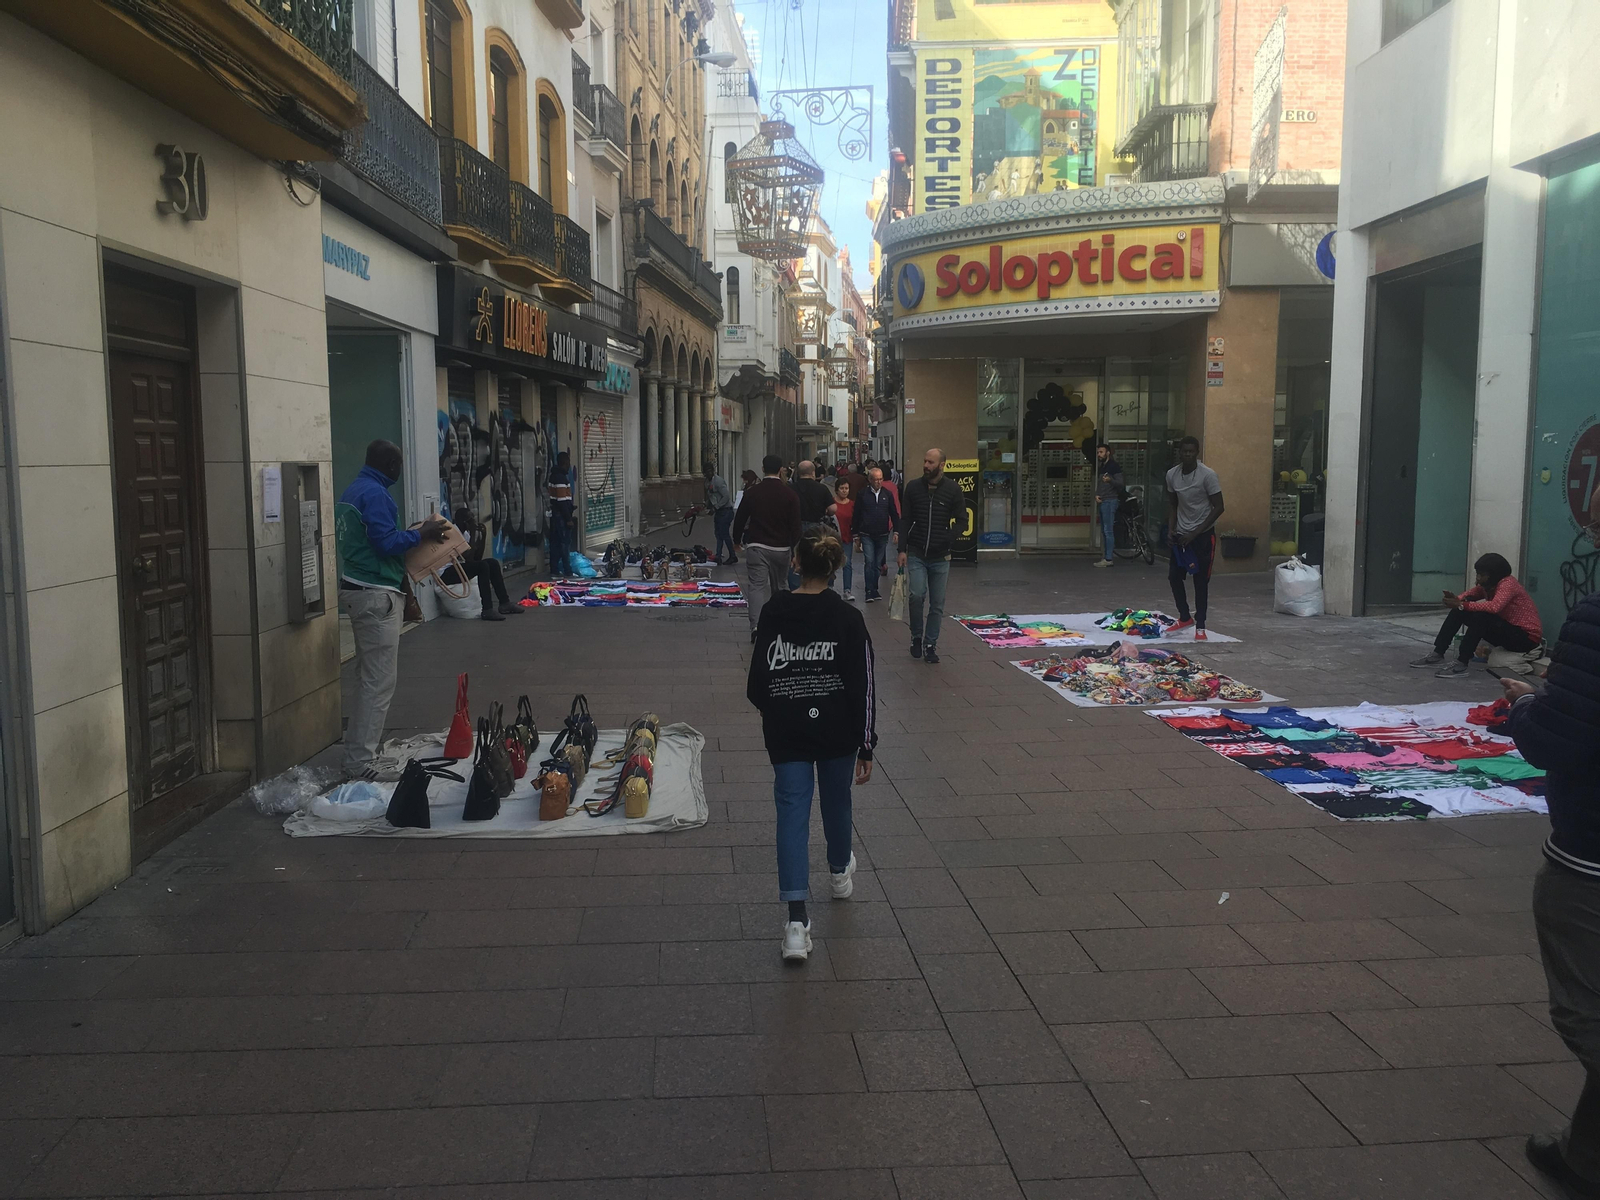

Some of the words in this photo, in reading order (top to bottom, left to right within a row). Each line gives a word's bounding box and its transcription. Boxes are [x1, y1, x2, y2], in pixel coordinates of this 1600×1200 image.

[1053, 49, 1079, 80] Z
[1285, 110, 1316, 121] ERO
[924, 58, 963, 212] DEPORTES
[157, 144, 209, 221] 30
[321, 233, 371, 281] MARYPAZ
[935, 228, 1204, 299] Soloptical
[504, 295, 548, 359] LLORENS
[552, 331, 577, 366] SALÓN
[578, 340, 587, 368] DE
[1578, 413, 1598, 432] CIERRE
[958, 476, 974, 486] ACK
[961, 484, 975, 492] DAY
[1570, 456, 1598, 512] -7
[767, 634, 838, 670] AVENGERS
